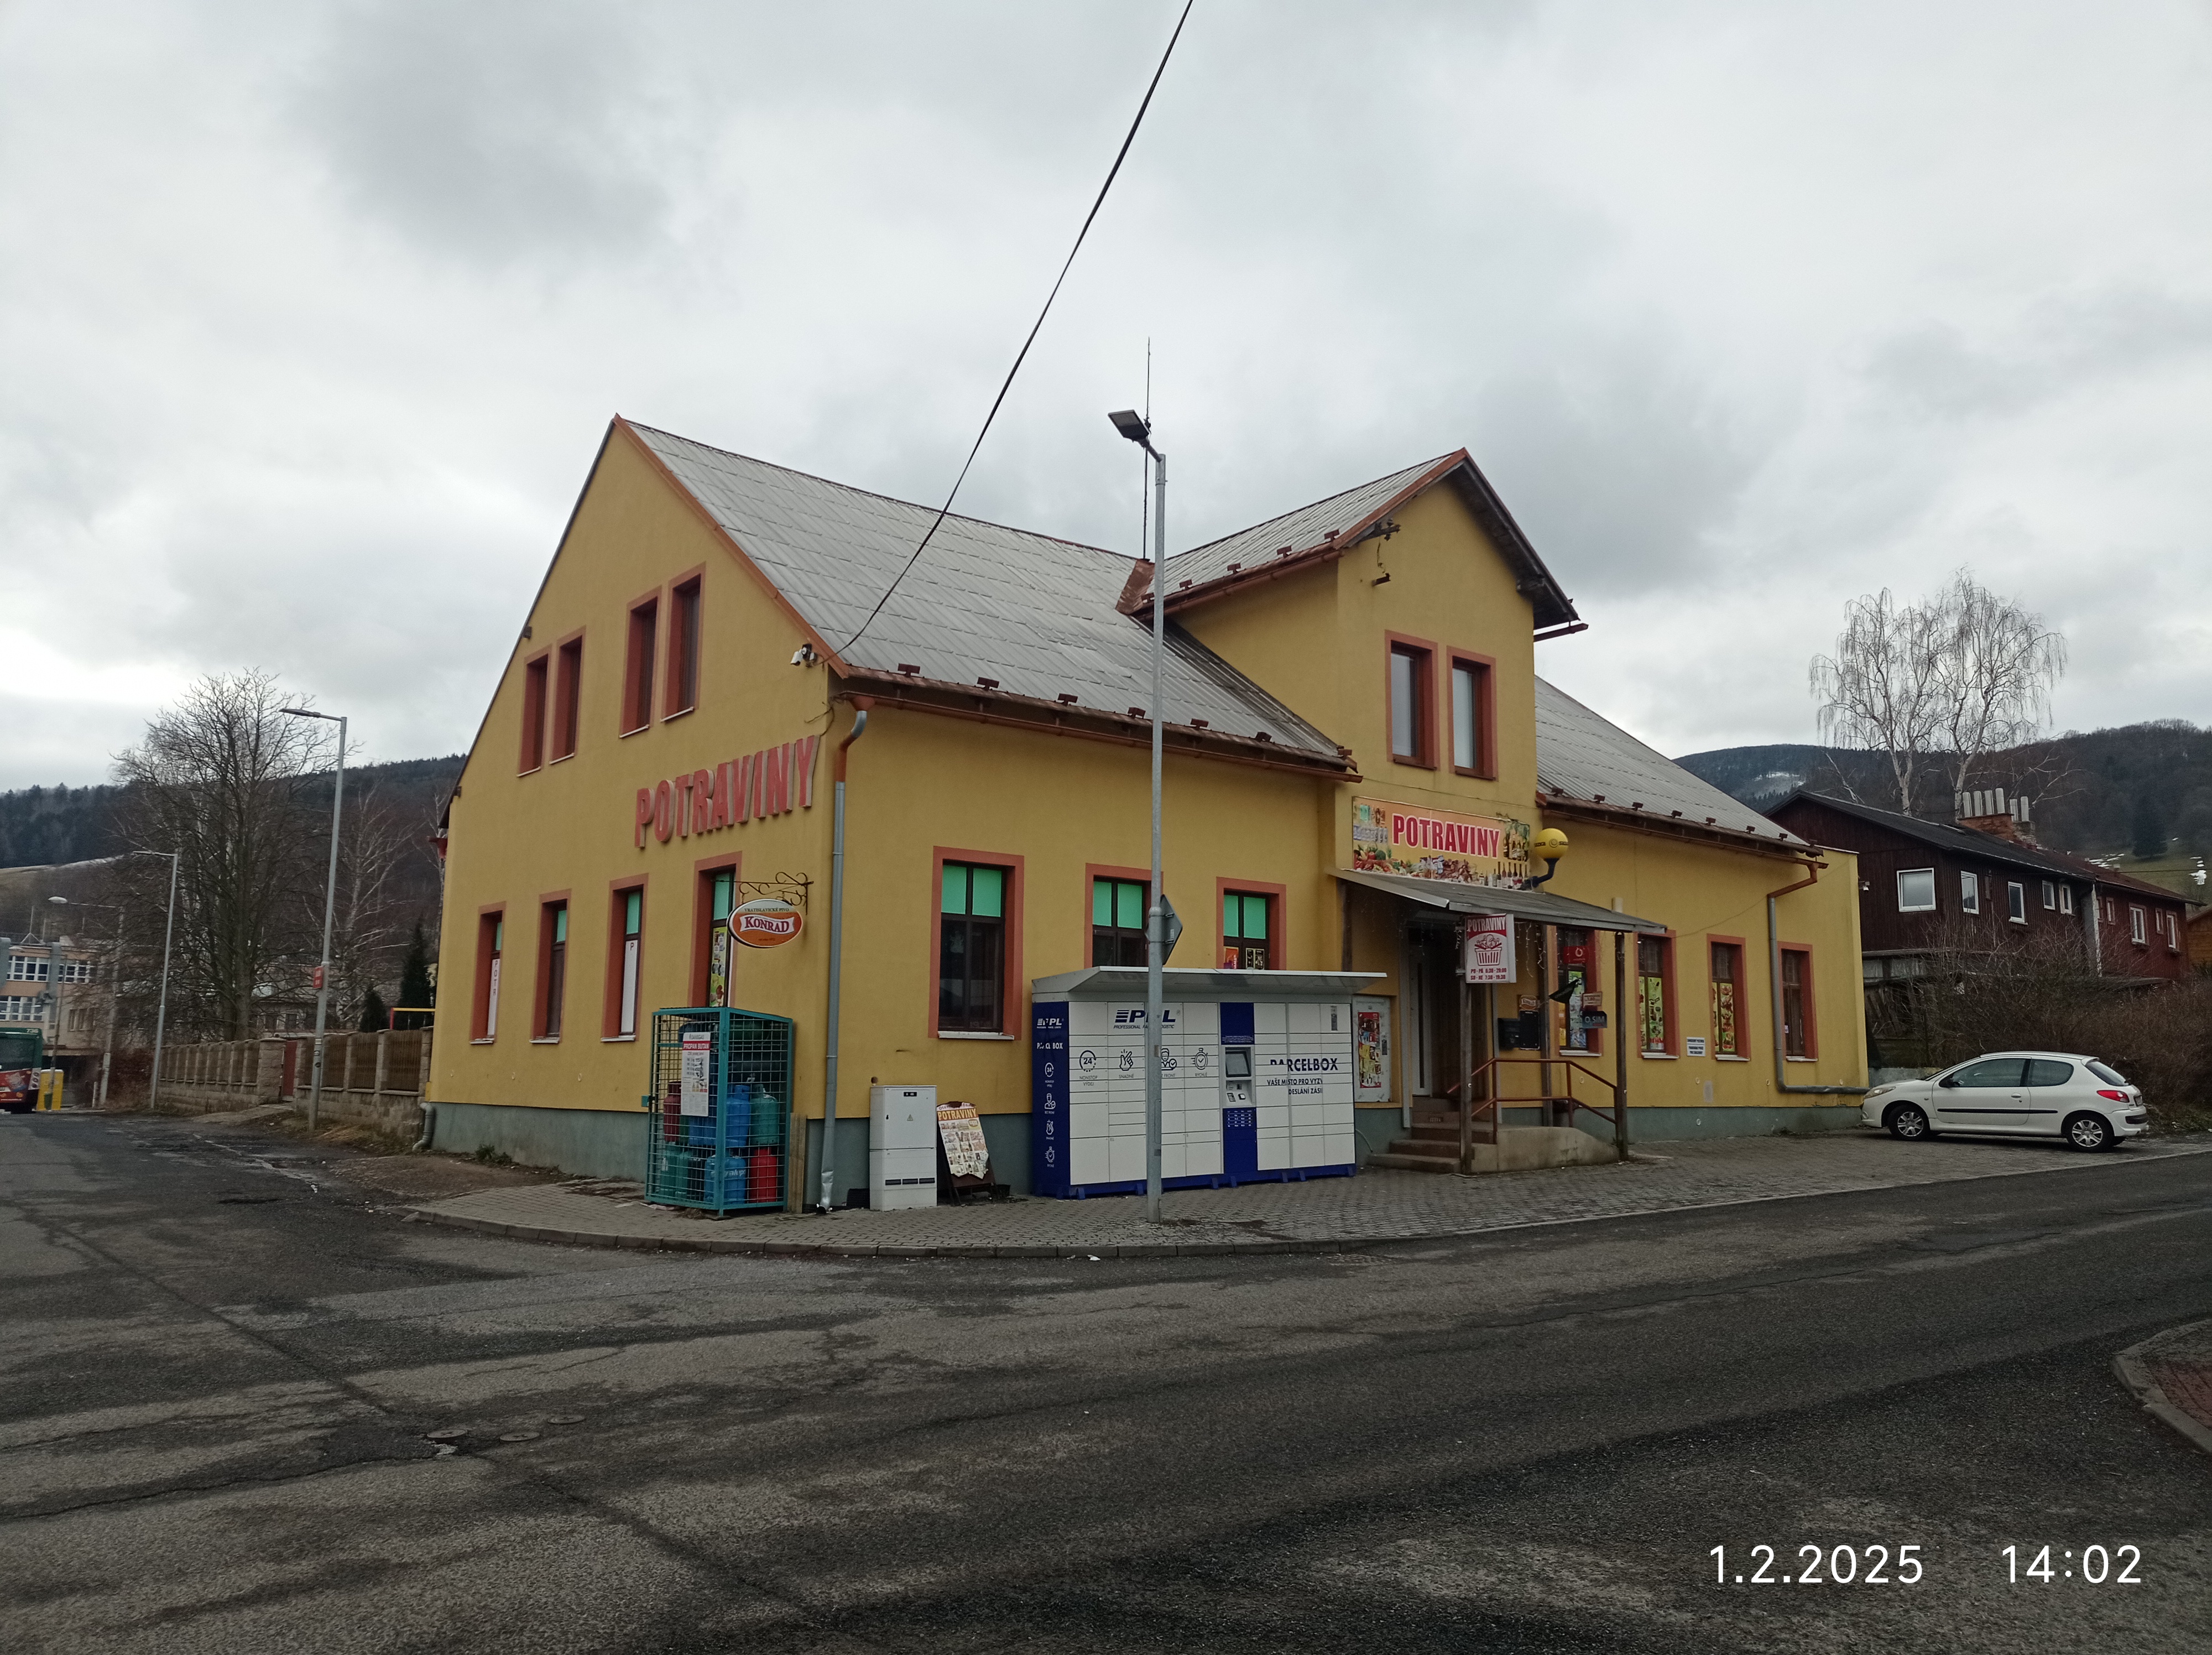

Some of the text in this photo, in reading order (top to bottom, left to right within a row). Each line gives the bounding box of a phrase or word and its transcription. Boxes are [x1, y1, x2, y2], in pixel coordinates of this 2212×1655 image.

[635, 735, 821, 848] POTRAVINY
[1392, 813, 1500, 859] POTRAVINY
[744, 916, 790, 933] KONRAD
[1467, 917, 1505, 932] POTRAVINY
[1267, 1078, 1280, 1086] VAŠE
[937, 1108, 976, 1120] POTRAVINY
